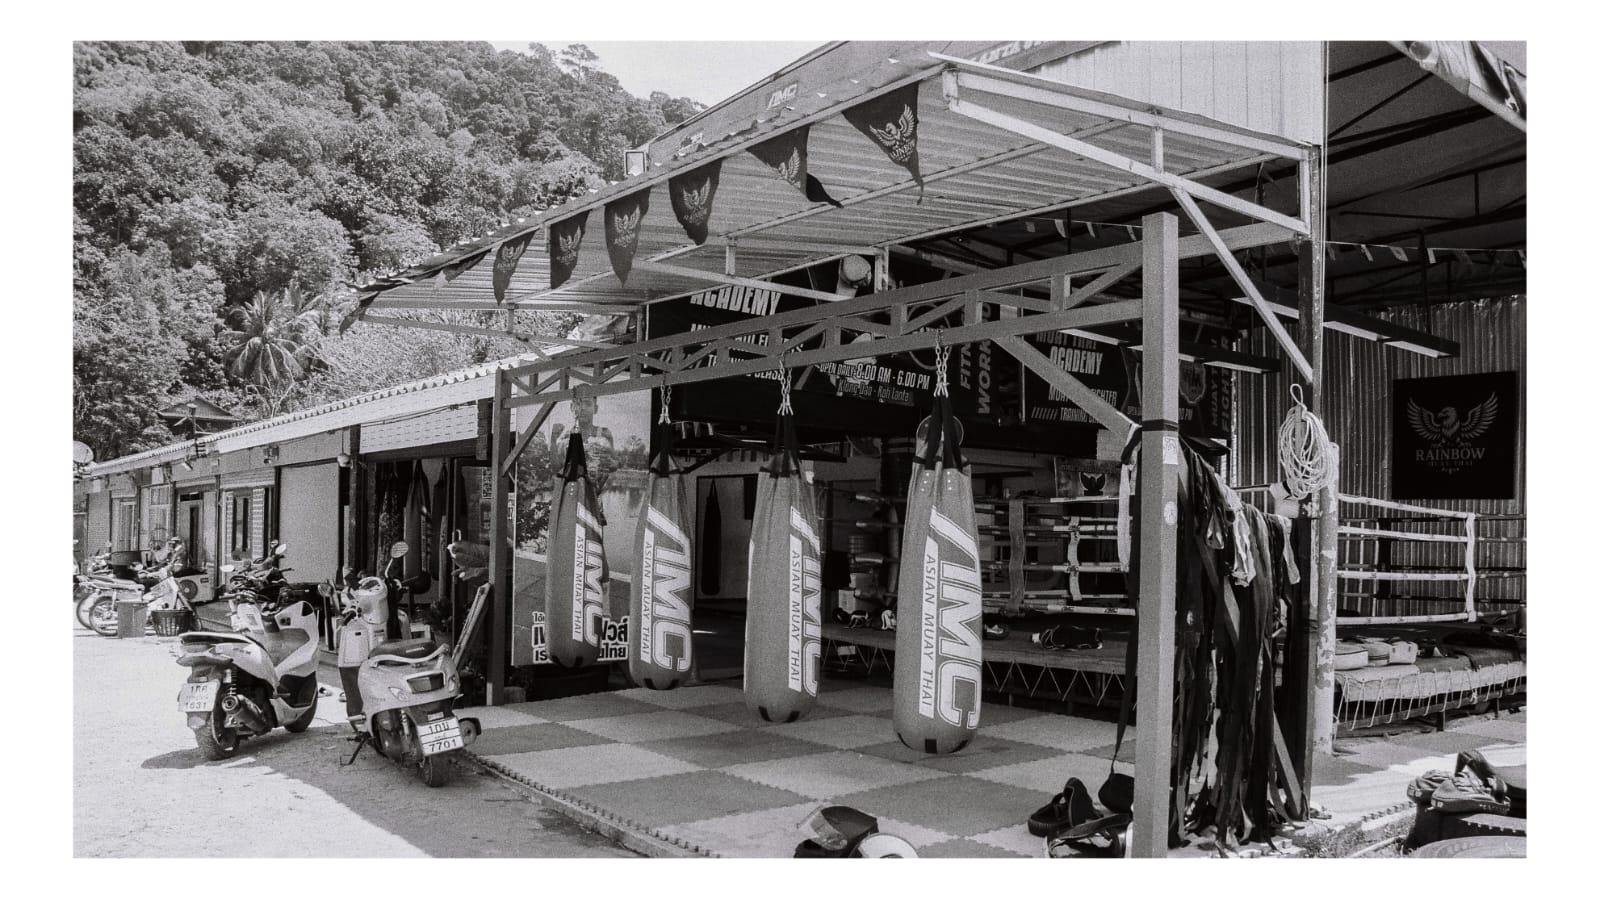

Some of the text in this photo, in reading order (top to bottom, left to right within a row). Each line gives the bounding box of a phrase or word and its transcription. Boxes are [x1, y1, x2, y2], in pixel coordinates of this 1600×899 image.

[877, 366, 891, 383] AM
[897, 370, 916, 388] 6.00
[917, 374, 930, 390] PM
[1415, 447, 1485, 461] RAINBOW
[642, 541, 653, 654] ASIAN MUAY THAI
[791, 551, 801, 681] ASIAN MUAY THAI
[922, 554, 936, 707] ASIAN MUAY THAI
[428, 738, 456, 752] 7701
